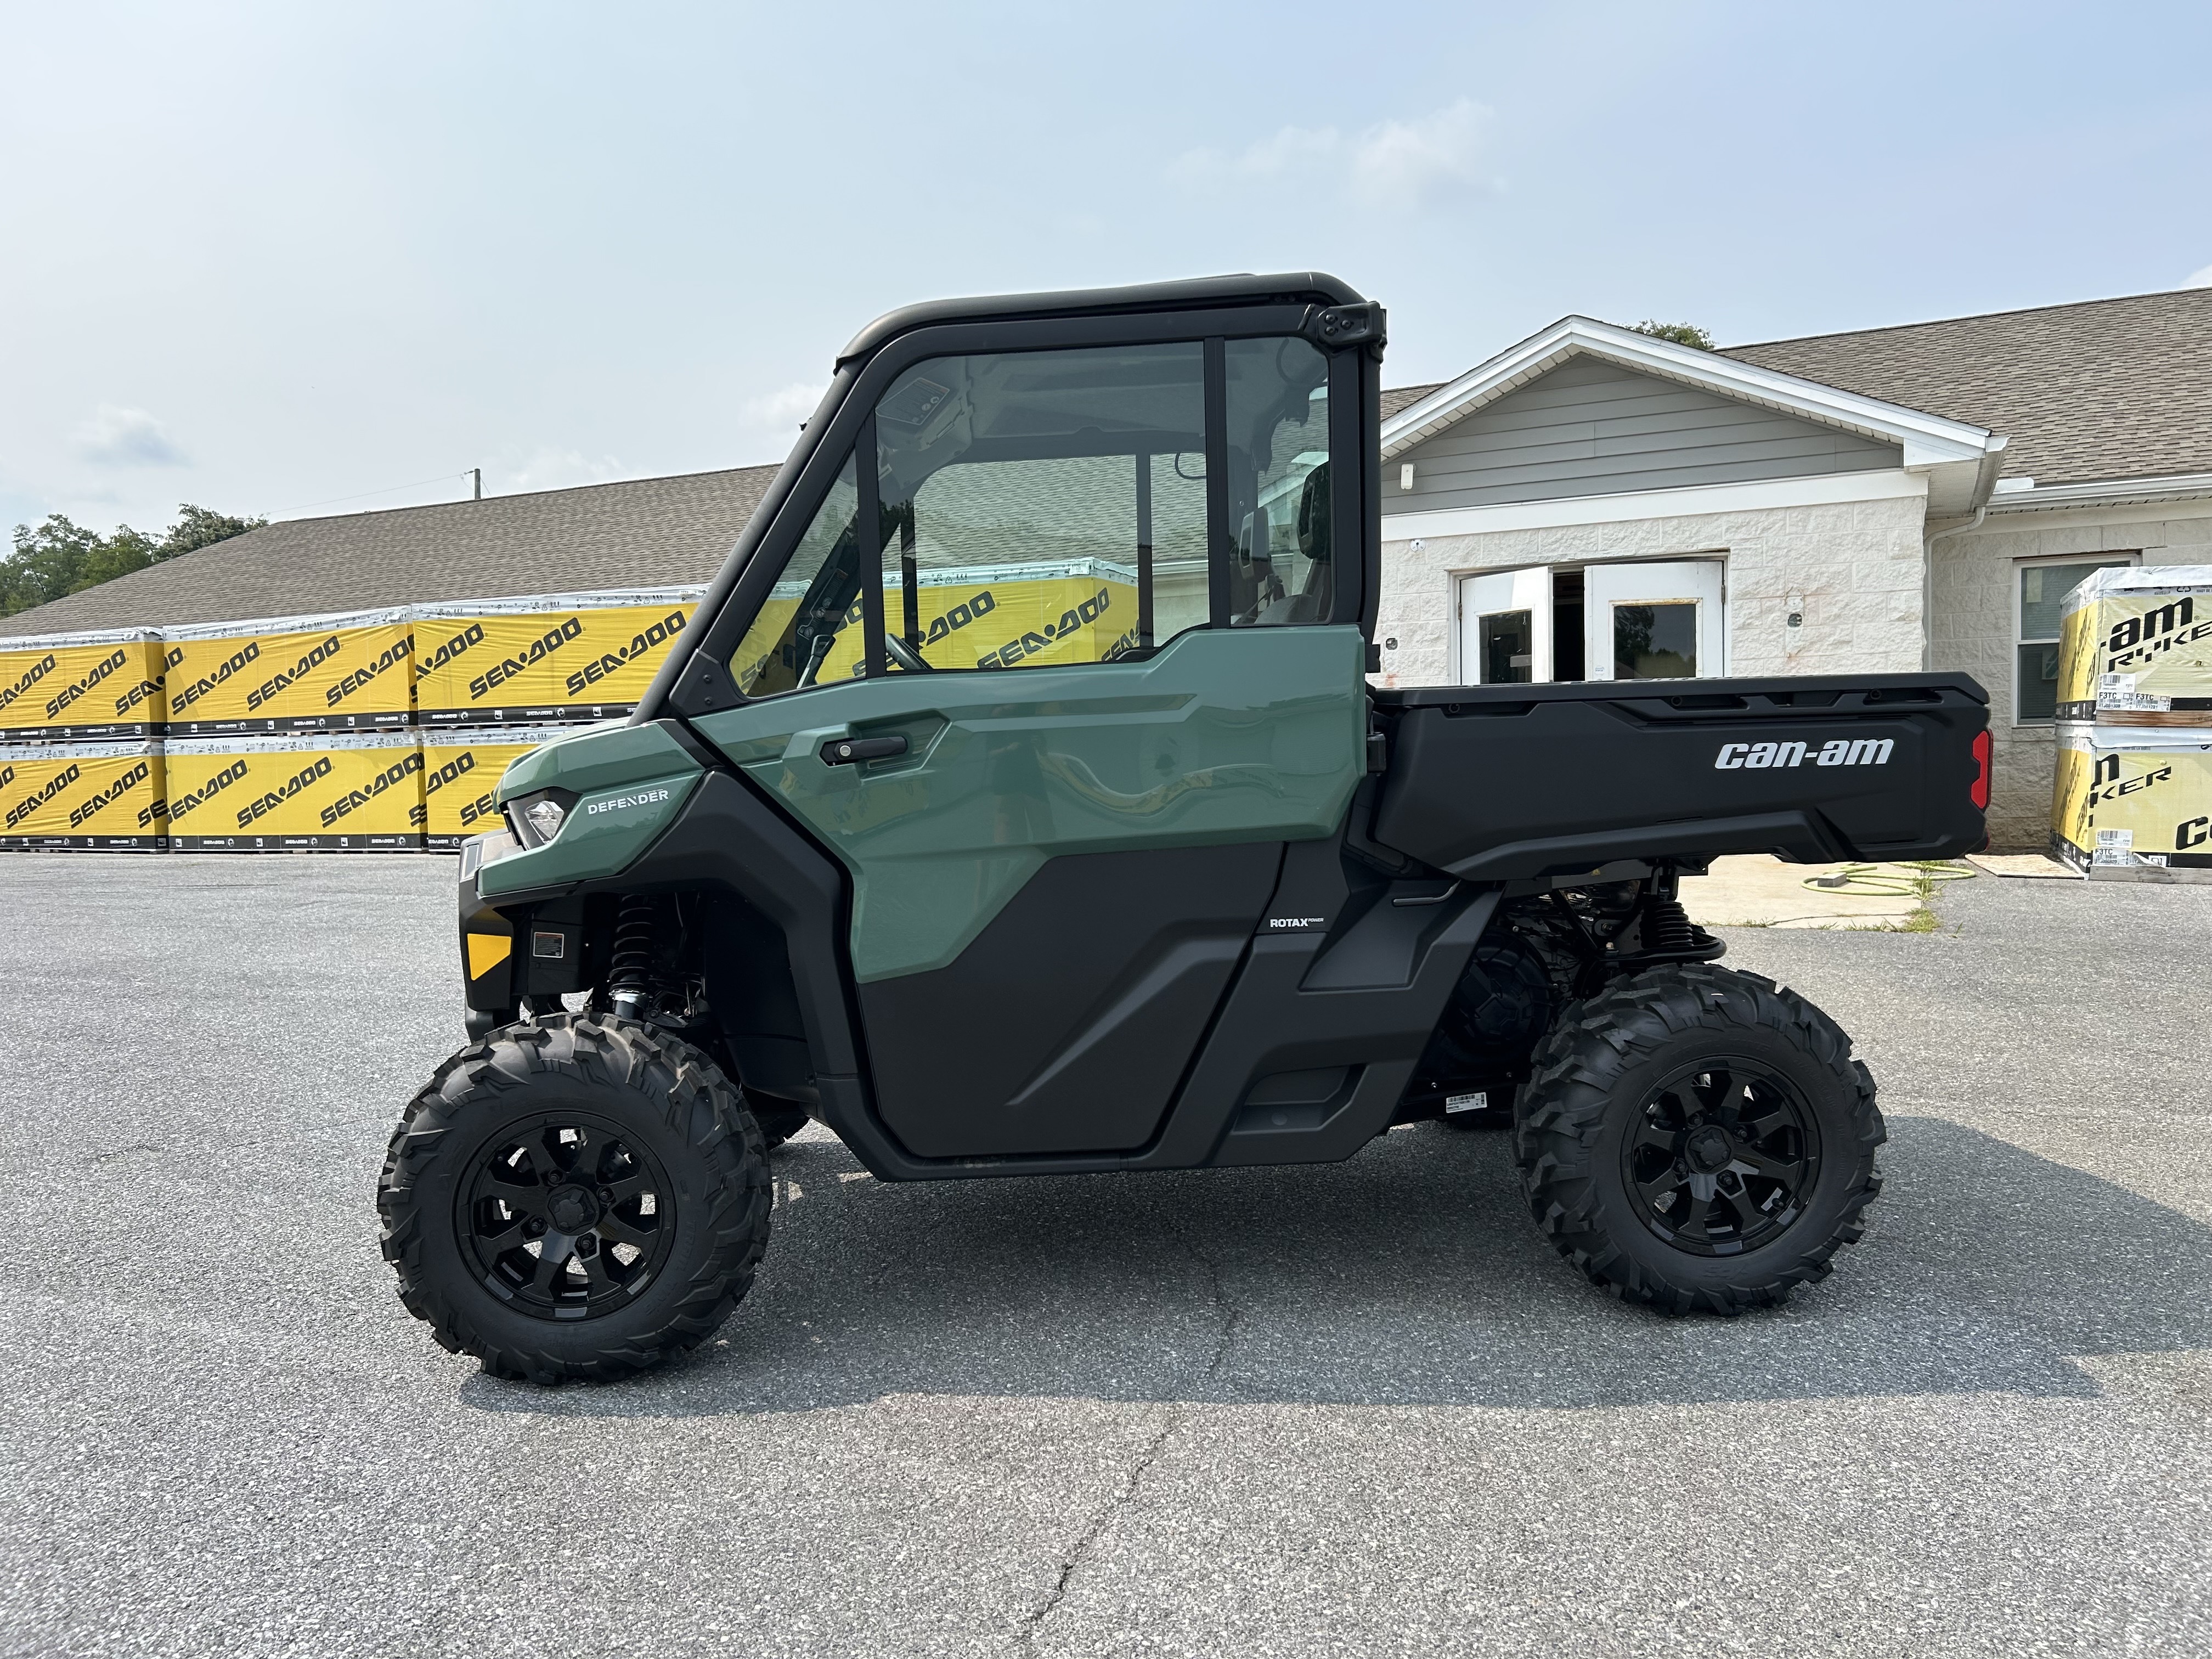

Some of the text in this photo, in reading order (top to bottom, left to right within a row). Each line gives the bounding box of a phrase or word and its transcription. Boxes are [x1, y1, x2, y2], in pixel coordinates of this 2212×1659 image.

[2108, 620, 2212, 673] RYKE
[1714, 738, 1894, 769] can-am
[588, 789, 669, 815] DEFENDER
[1269, 918, 1308, 928] ROTAX
